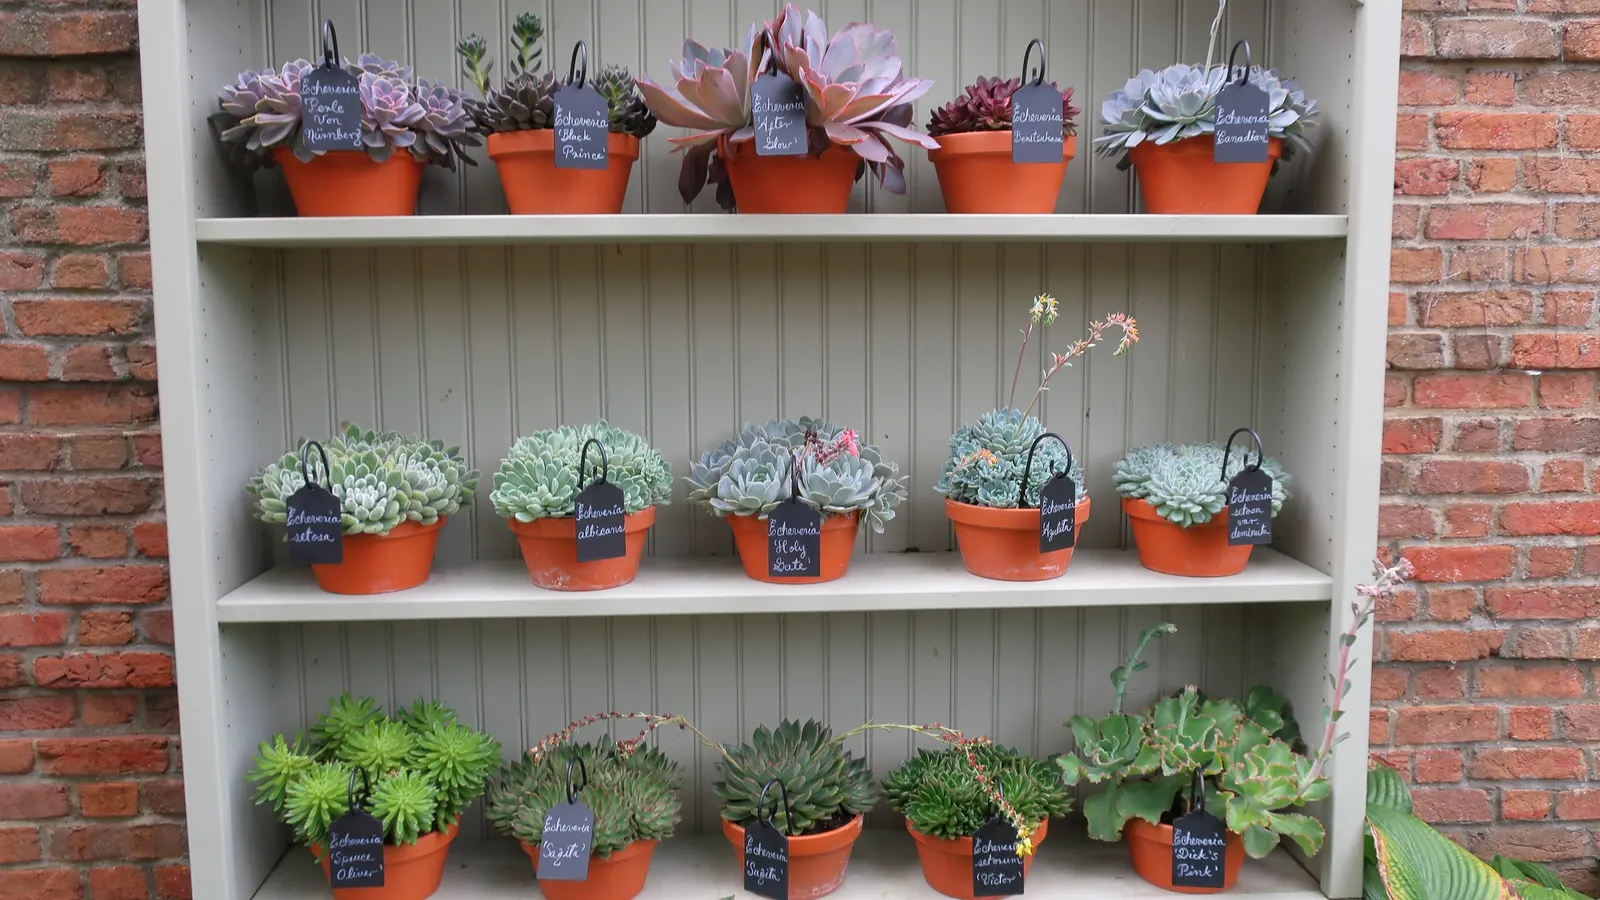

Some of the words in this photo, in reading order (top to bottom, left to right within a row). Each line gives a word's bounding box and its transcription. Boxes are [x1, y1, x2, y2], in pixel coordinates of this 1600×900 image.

[301, 78, 360, 95] Echeveria
[752, 92, 804, 113] Echeveria
[554, 104, 608, 127] Echeveria
[1012, 101, 1063, 123] Echeveria
[1215, 105, 1270, 125] Echeveria
[558, 128, 591, 142] 'Black
[562, 145, 605, 160] Prince'
[1230, 486, 1272, 504] Echeveria
[575, 502, 625, 521] Echeveria
[1041, 495, 1075, 517] Echeveria
[1231, 503, 1264, 516] setosa
[286, 506, 342, 526] Echeveria
[289, 526, 335, 542] setosa
[577, 523, 626, 540] albicans
[768, 518, 820, 536] Echeveria
[774, 539, 806, 559] 'Holy
[543, 814, 590, 833] Echeveria
[329, 832, 383, 849] Echeveria
[973, 837, 1017, 855] Echeveri
[1172, 828, 1226, 846] Echeveria
[745, 834, 788, 863] Echeveria
[331, 851, 375, 867] 'Spruce
[336, 864, 383, 880] Oliver'
[976, 871, 1022, 886] 'Victor'
[1177, 863, 1219, 878] Pink'
